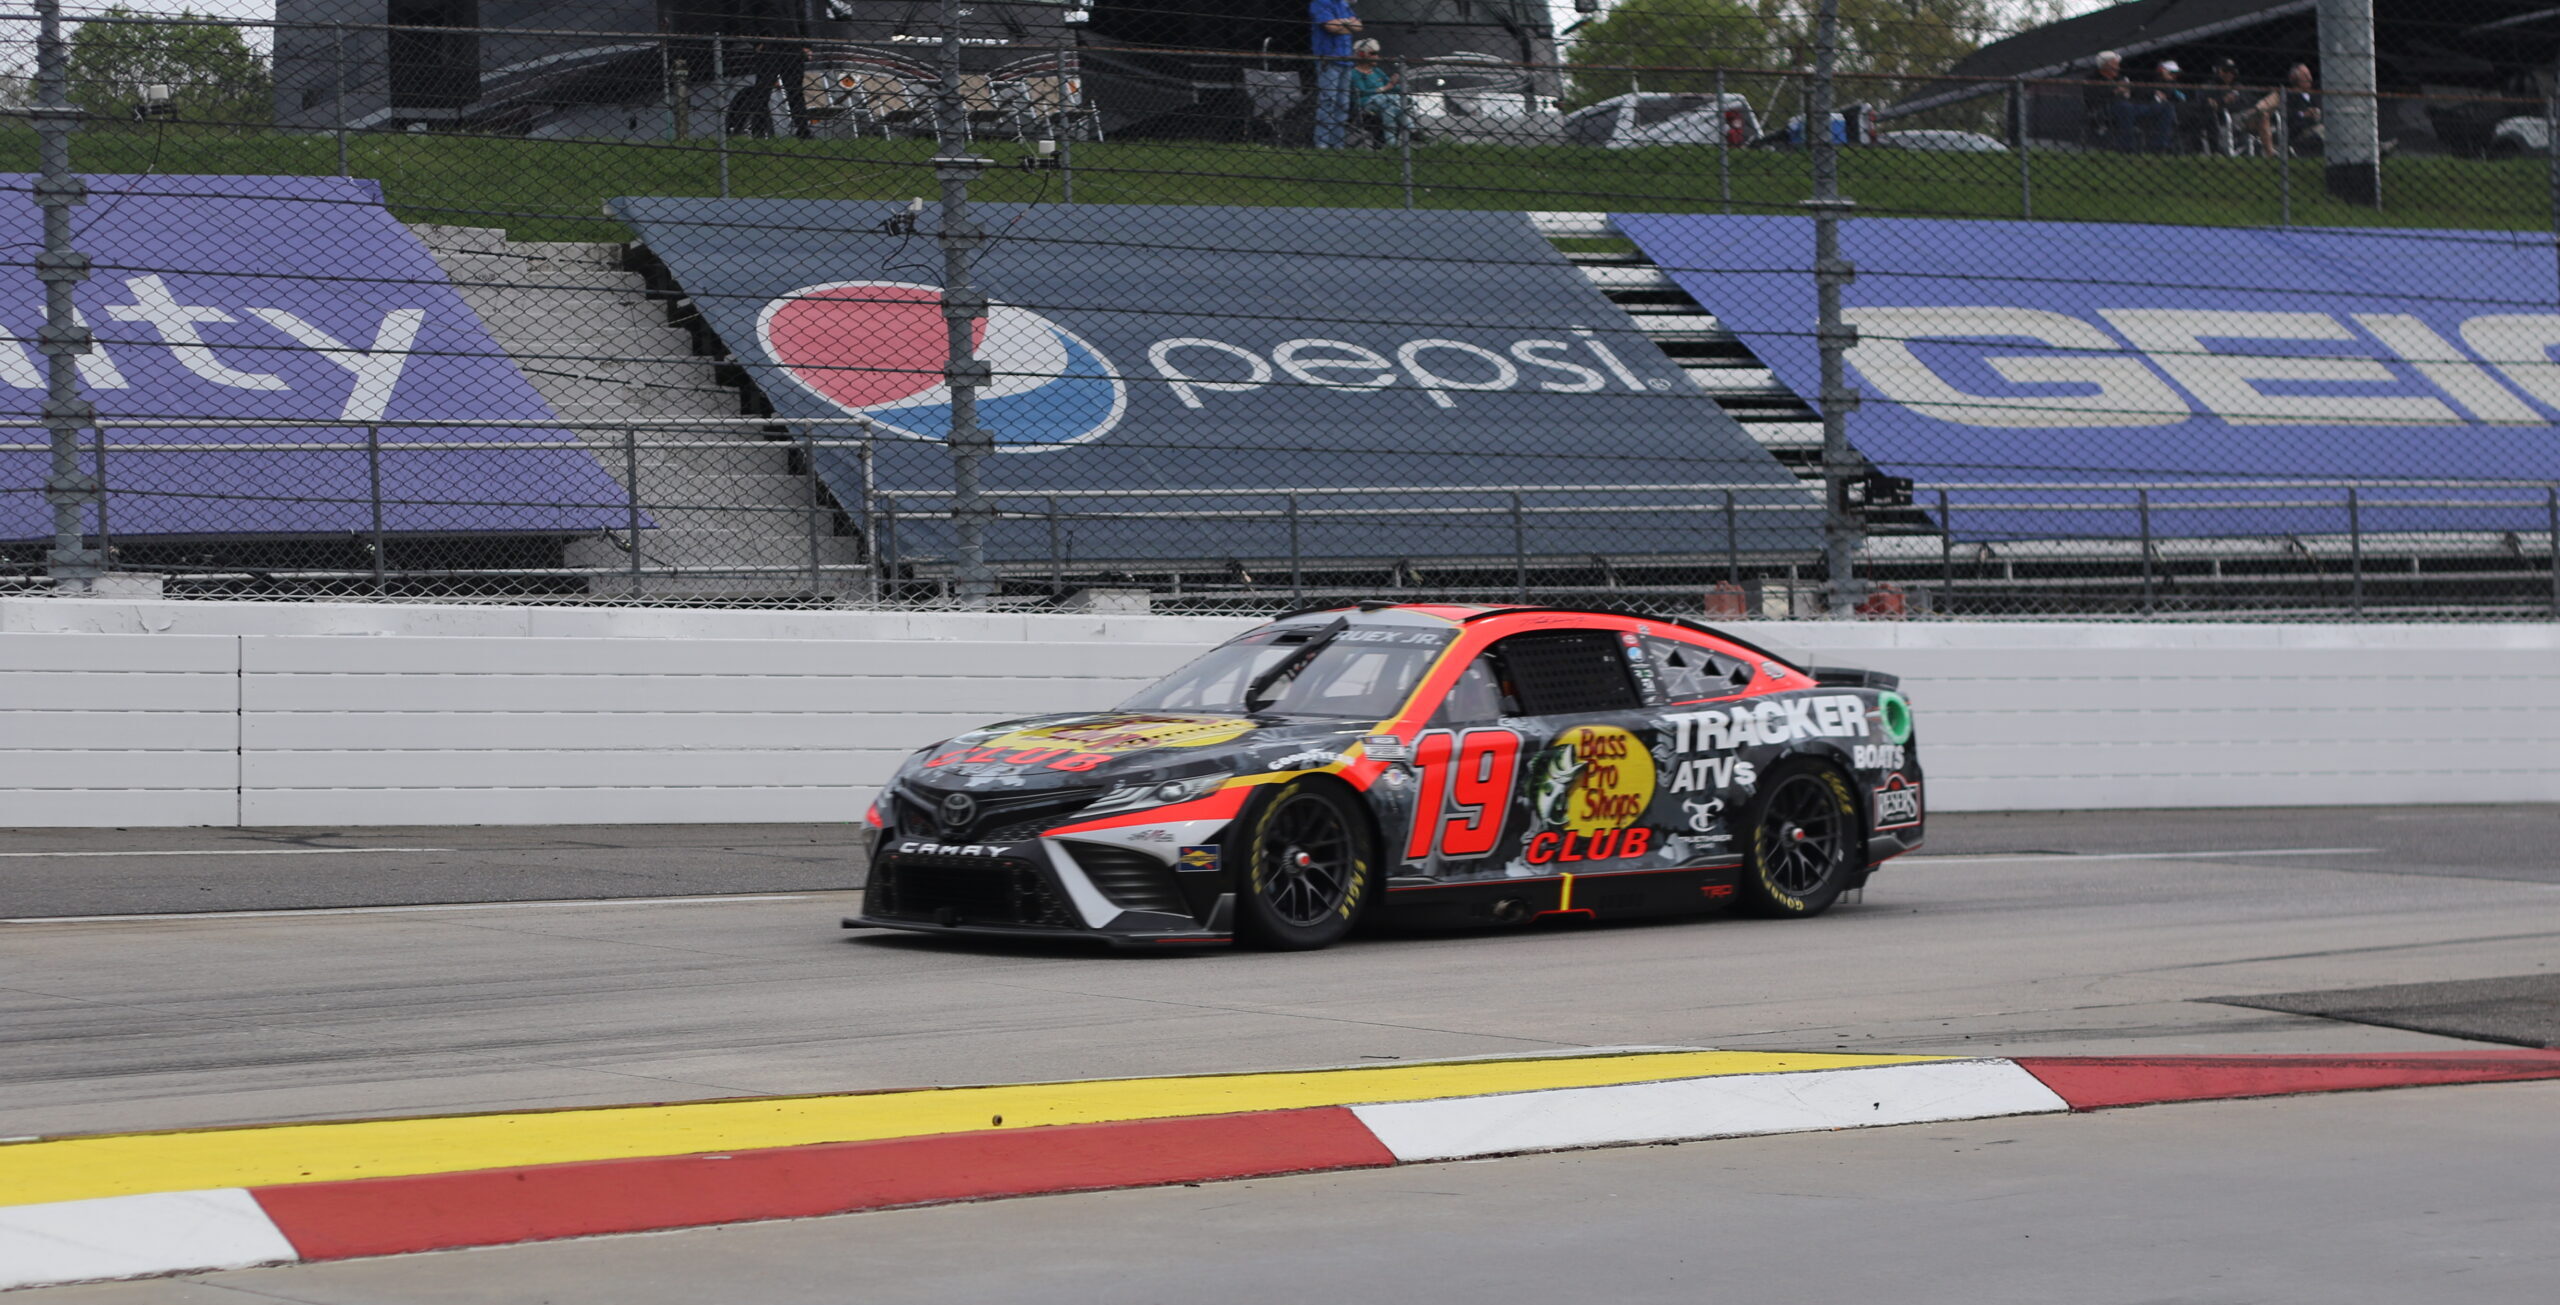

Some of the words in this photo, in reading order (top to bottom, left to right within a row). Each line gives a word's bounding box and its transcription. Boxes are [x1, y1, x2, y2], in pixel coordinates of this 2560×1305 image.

[1148, 324, 1647, 408] pepsi
[1331, 630, 1399, 643] RUEX
[1400, 633, 1444, 646] JR.
[1661, 695, 1869, 754] TRACKER
[925, 746, 1113, 772] CLUB
[1578, 729, 1627, 759] Bass
[1853, 745, 1905, 769] BOATS
[1581, 758, 1618, 789] Pro
[1403, 727, 1521, 864] 19
[1580, 787, 1640, 825] Shops
[1526, 827, 1652, 865] CLUB
